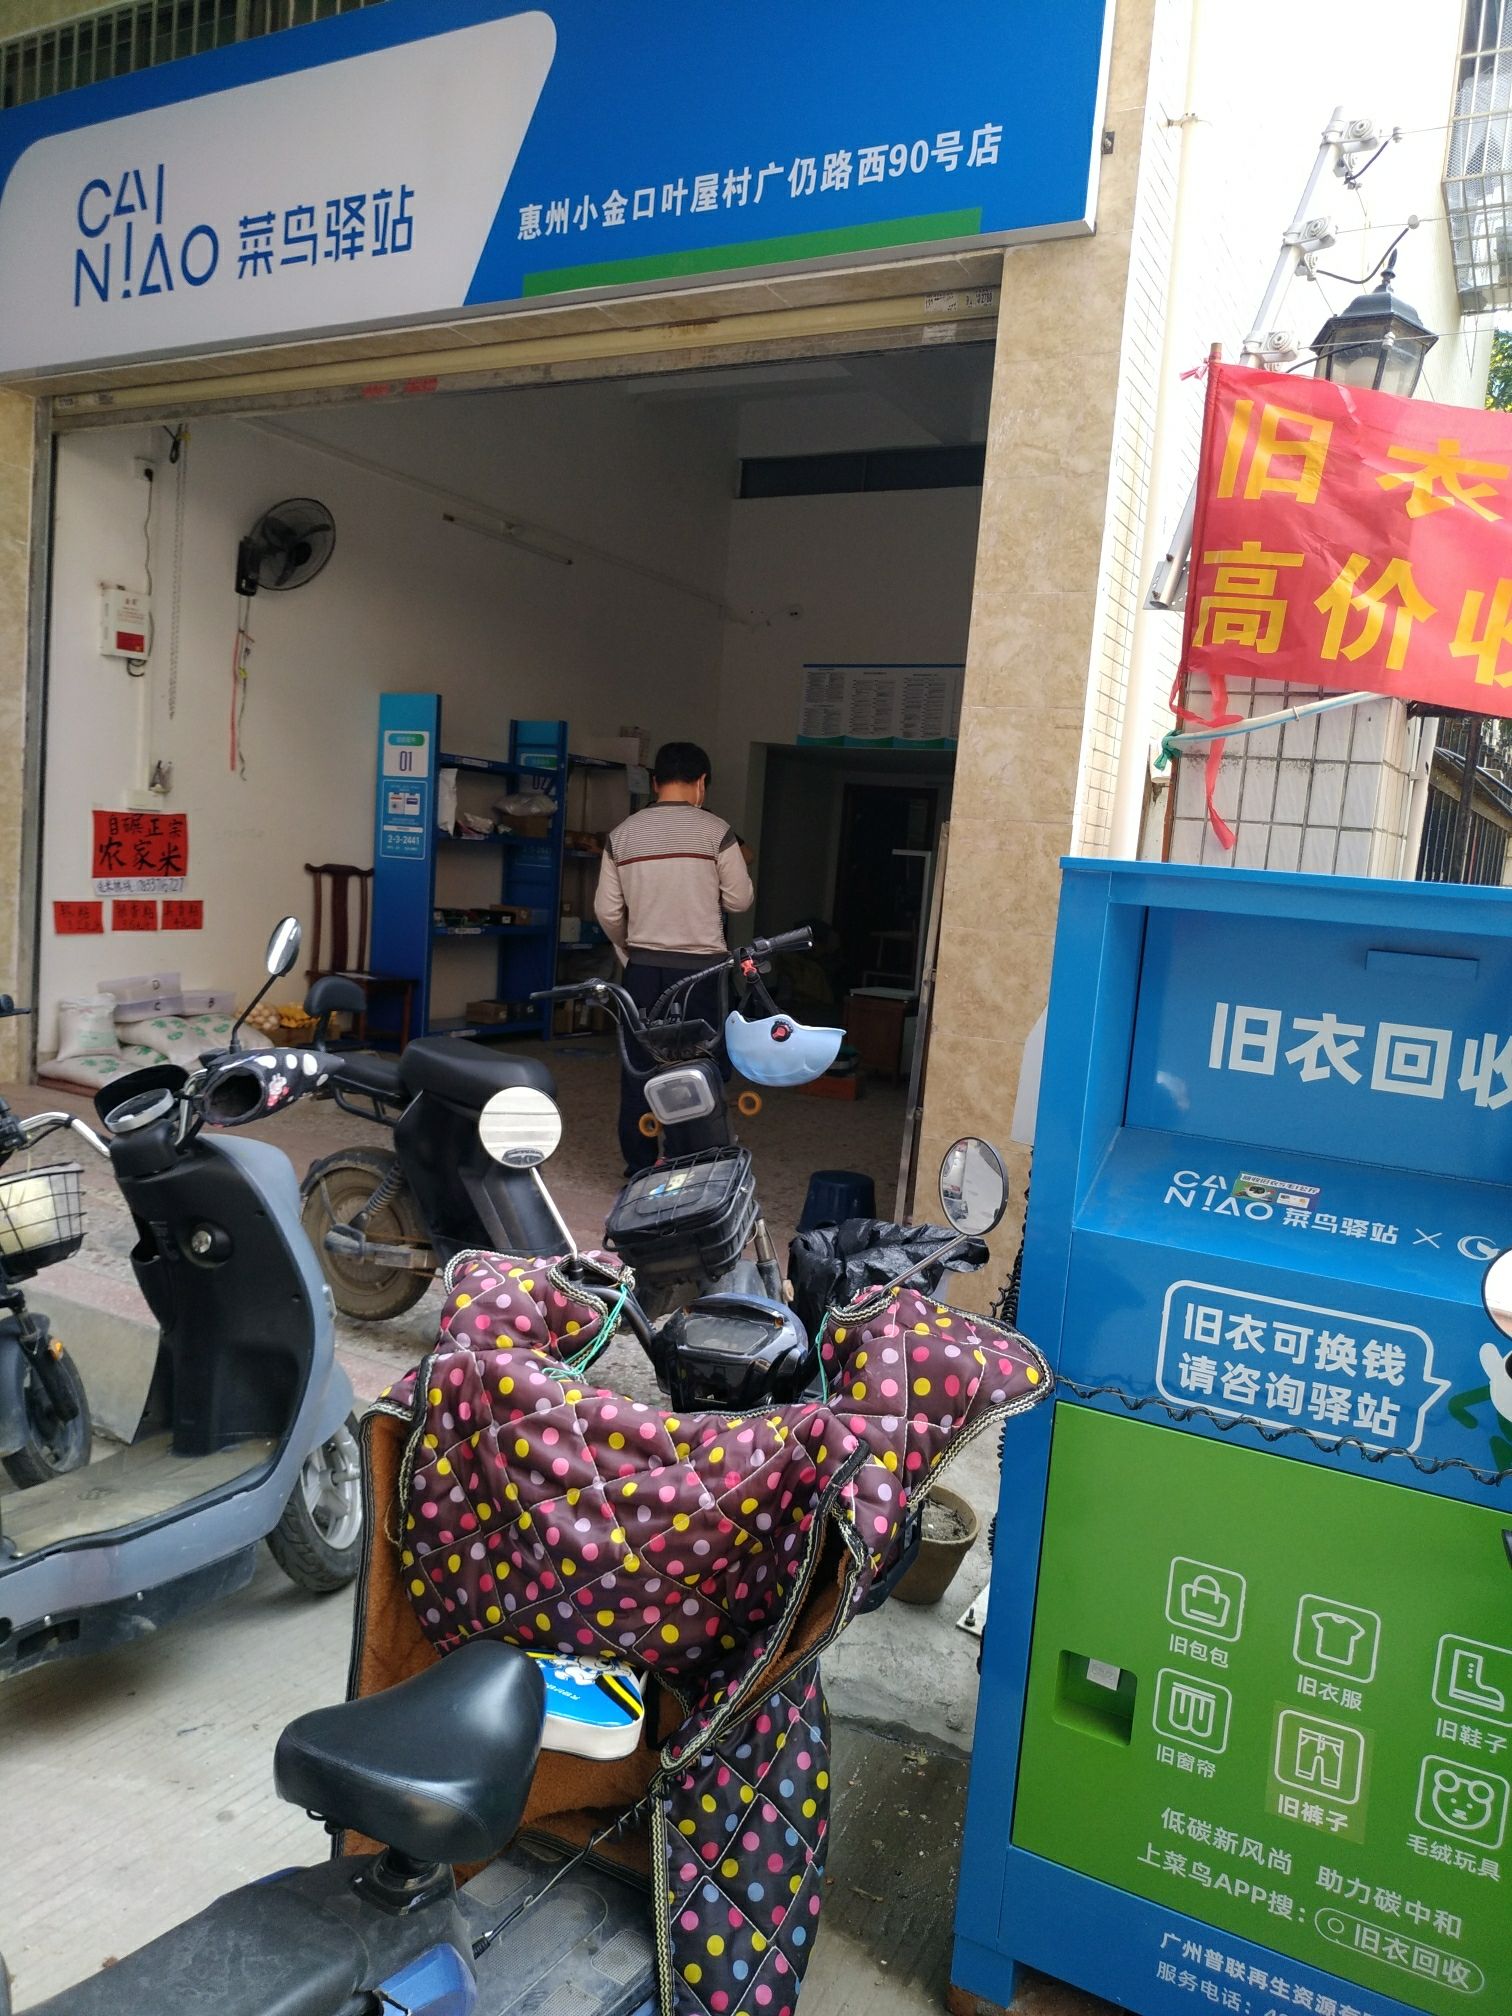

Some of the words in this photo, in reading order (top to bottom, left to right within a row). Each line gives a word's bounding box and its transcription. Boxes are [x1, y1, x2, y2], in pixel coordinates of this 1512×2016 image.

[78, 164, 164, 238] CAI
[517, 123, 1003, 241] 惠州小金口叶屋村广仍路西90号店
[238, 184, 414, 279] 菜鸟驿站
[1217, 400, 1511, 522] 旧衣
[98, 837, 183, 877] 农家米
[1208, 1002, 1512, 1110] 旧衣回收
[1282, 1207, 1399, 1244] 菜鸟驿站
[1183, 1302, 1406, 1386] 旧衣可换钱
[1178, 1352, 1400, 1437] 请咨询驿站
[1169, 1633, 1229, 1669] 旧包包
[1297, 1674, 1362, 1712] 旧衣服
[1156, 1743, 1217, 1779] 旧窗帘
[1435, 1717, 1508, 1754] 旧鞋子
[1278, 1793, 1349, 1832] 旧裤子
[1160, 1806, 1292, 1875] 低碳新风尚
[1315, 1865, 1462, 1940] 助力碳中和
[1406, 1833, 1501, 1882] 毛绒玩具
[1354, 1922, 1472, 1989] 旧衣回收
